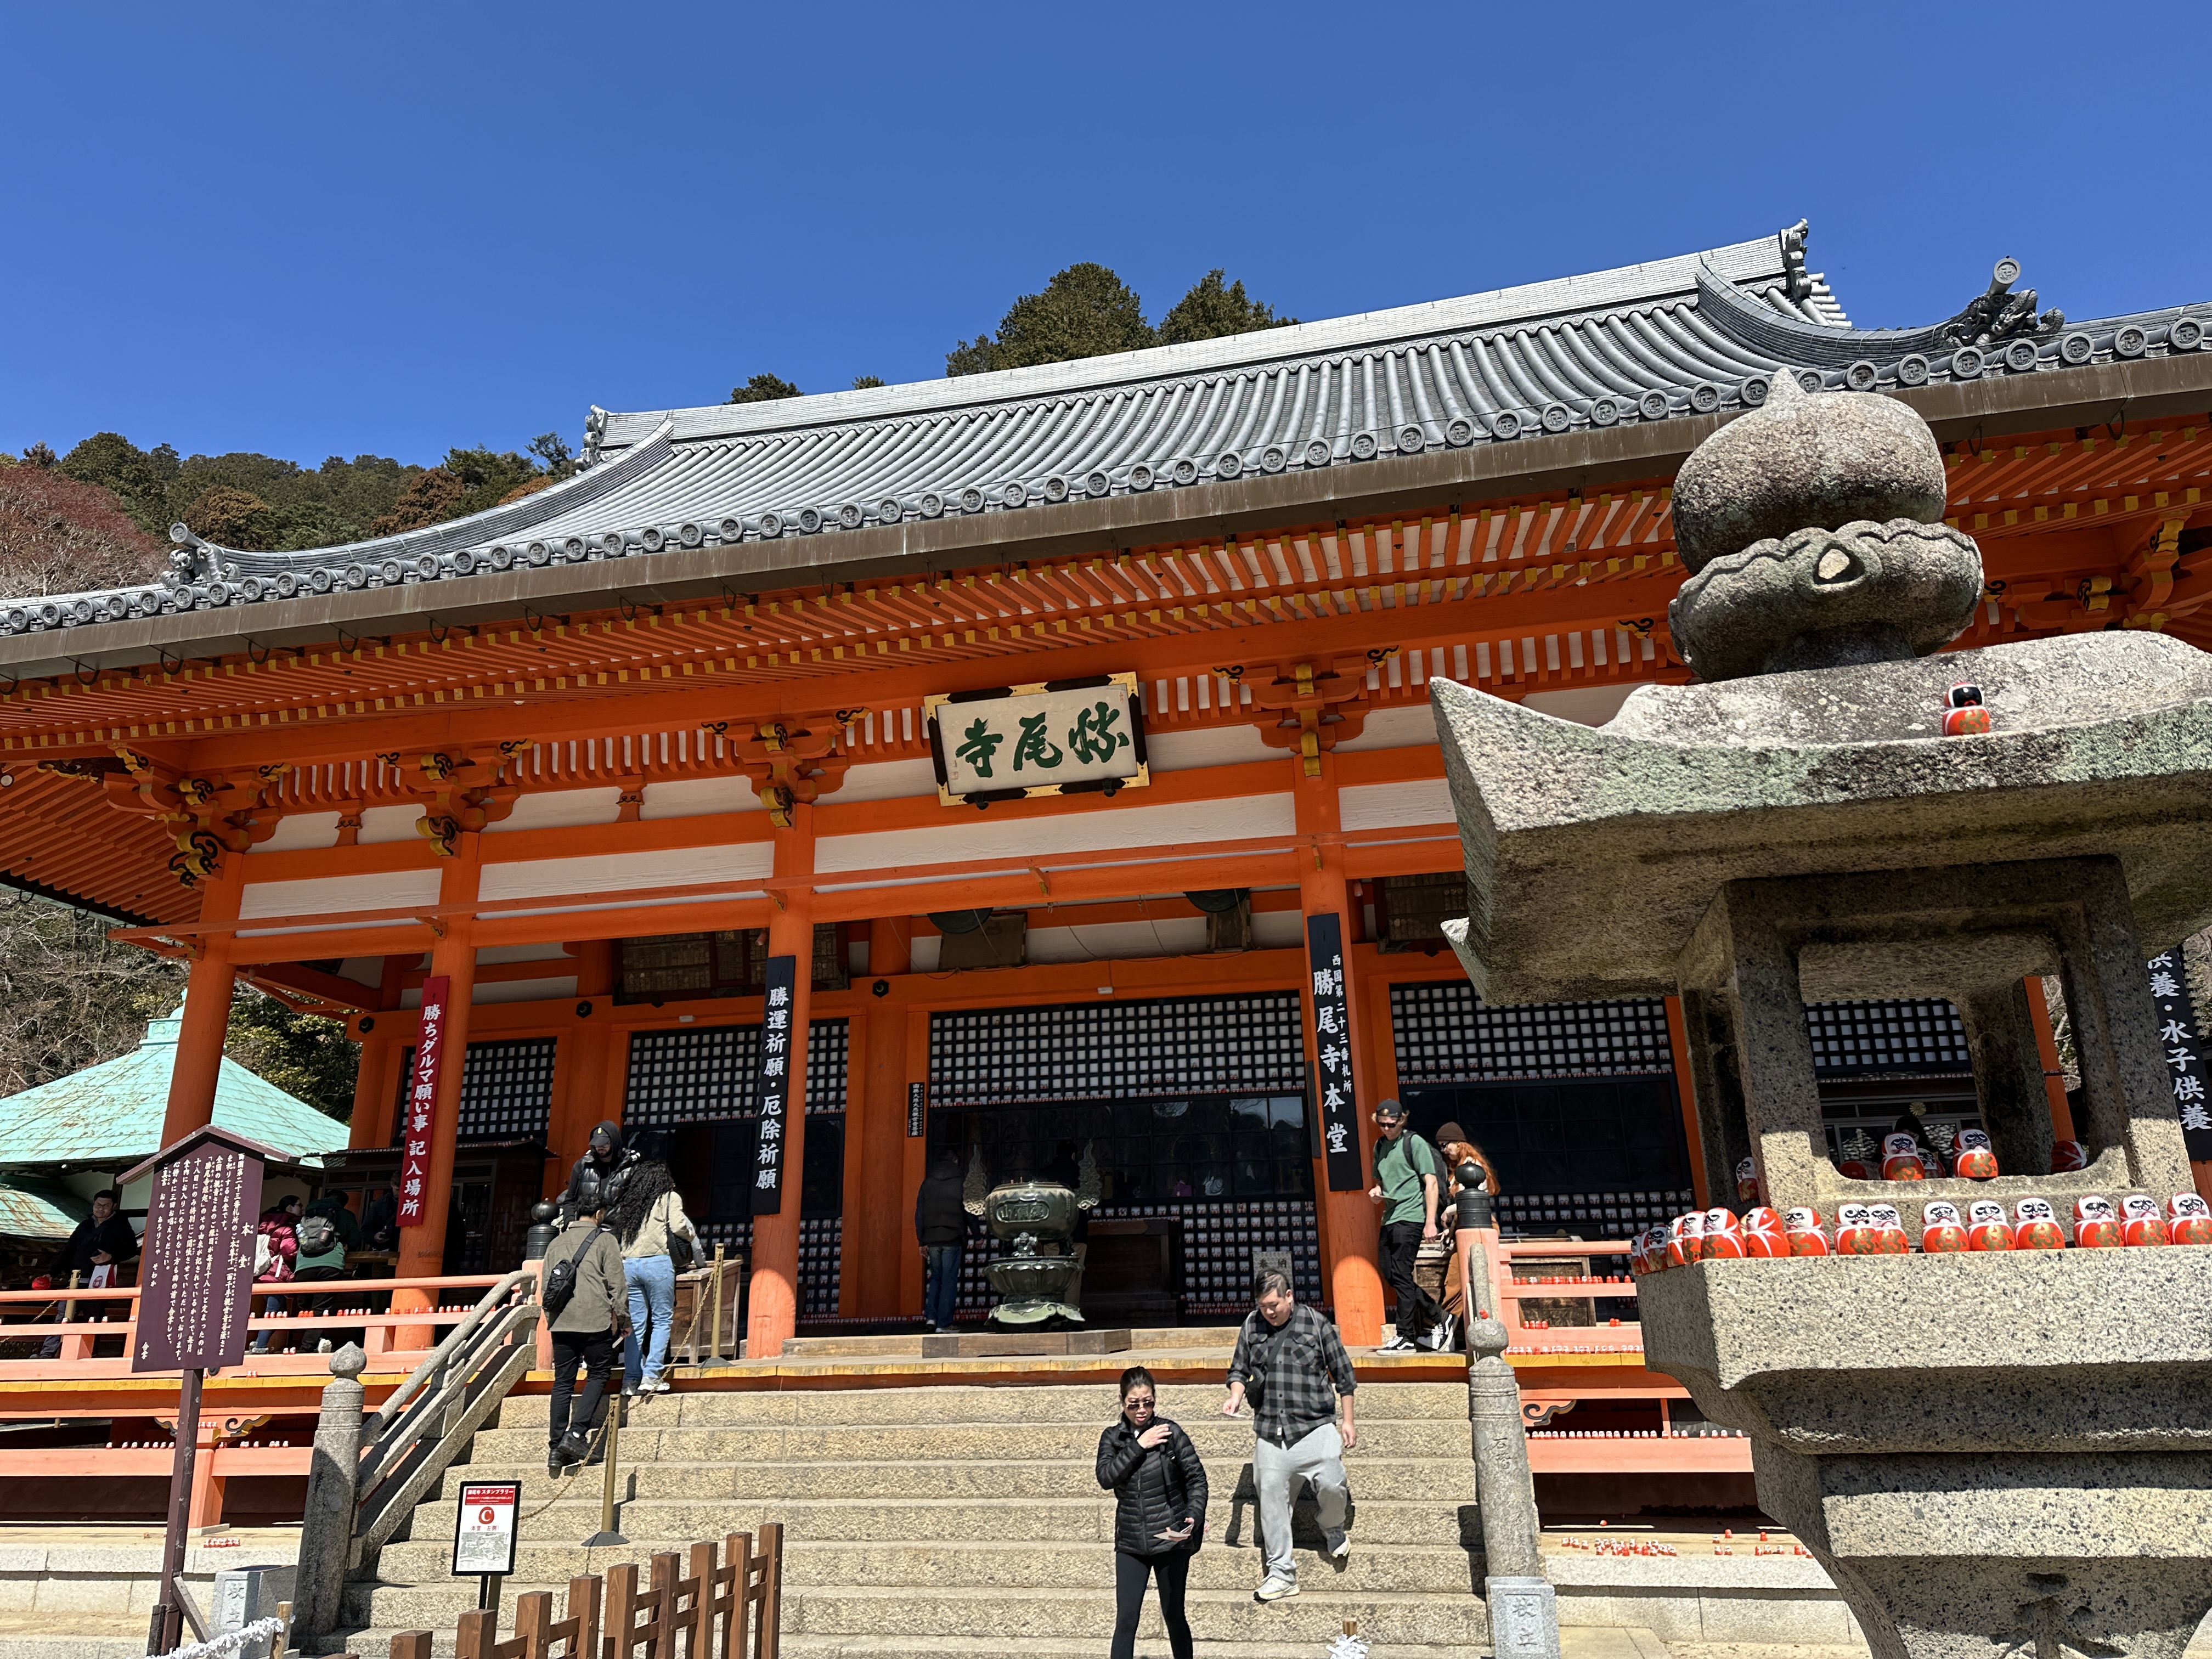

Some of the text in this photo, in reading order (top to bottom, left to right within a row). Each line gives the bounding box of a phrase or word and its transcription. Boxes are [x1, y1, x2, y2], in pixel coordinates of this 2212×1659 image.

[400, 1004, 441, 1217] 勝ちダルマ願い事 記入場所
[756, 986, 789, 1189] 勝運祈願・厄除祈願
[1313, 968, 1348, 1153] 勝尾寺本堂
[1332, 954, 1352, 1093] 西国第二十三番札所
[481, 1509, 492, 1522] C
